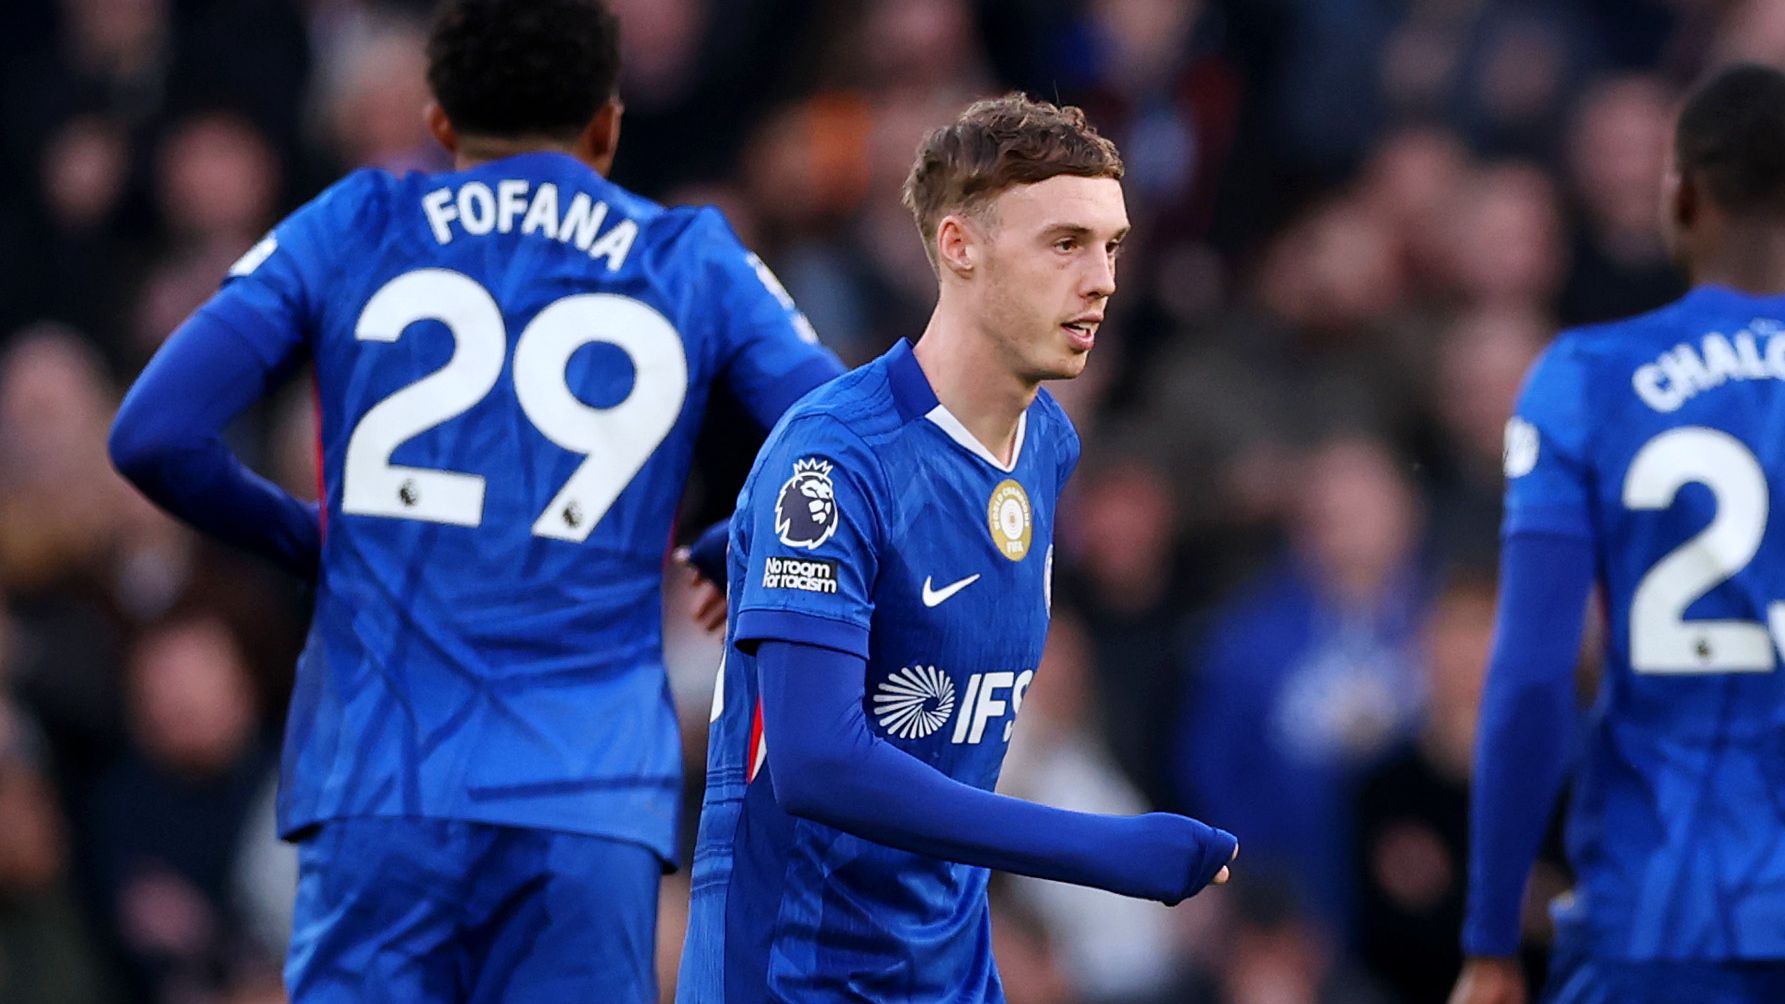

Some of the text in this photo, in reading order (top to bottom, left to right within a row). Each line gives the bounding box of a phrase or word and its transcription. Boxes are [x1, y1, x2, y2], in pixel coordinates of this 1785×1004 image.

[421, 178, 640, 273] FOFANA
[342, 267, 688, 543] 29
[766, 557, 830, 578] No room
[781, 574, 837, 593] racism
